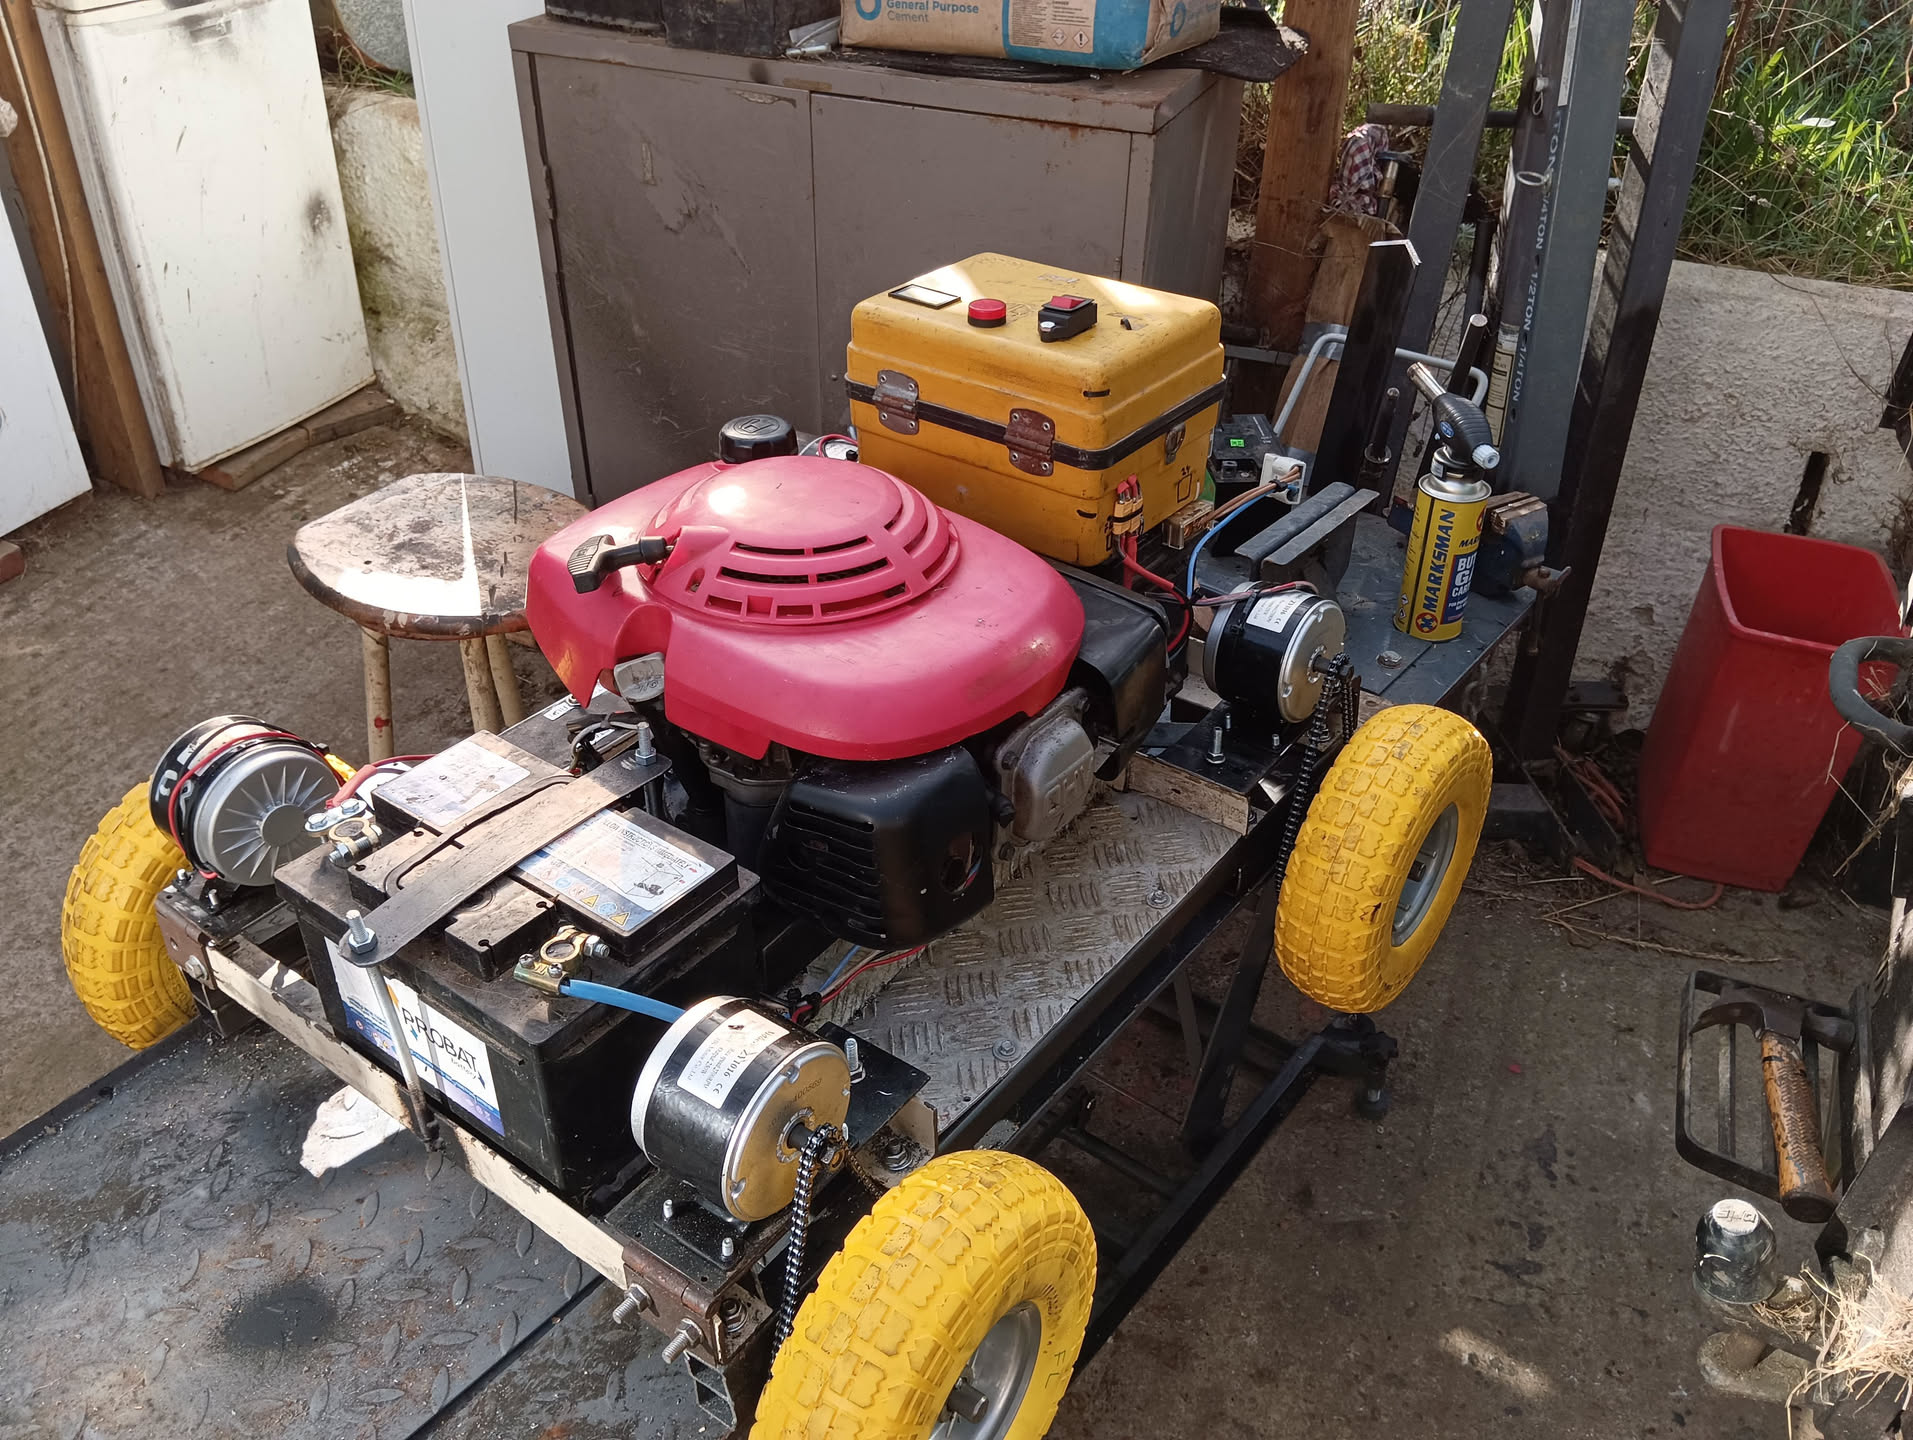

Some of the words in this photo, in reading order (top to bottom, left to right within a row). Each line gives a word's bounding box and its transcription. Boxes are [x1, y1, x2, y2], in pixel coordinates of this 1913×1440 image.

[886, 0, 929, 11] General
[932, 1, 979, 14] Purpose
[887, 10, 929, 22] Cement
[1512, 346, 1527, 401] 1/4TON
[1422, 509, 1456, 613] MARKSMAN
[401, 1007, 477, 1072] PROBAT
[722, 1048, 750, 1078] ZY1016
